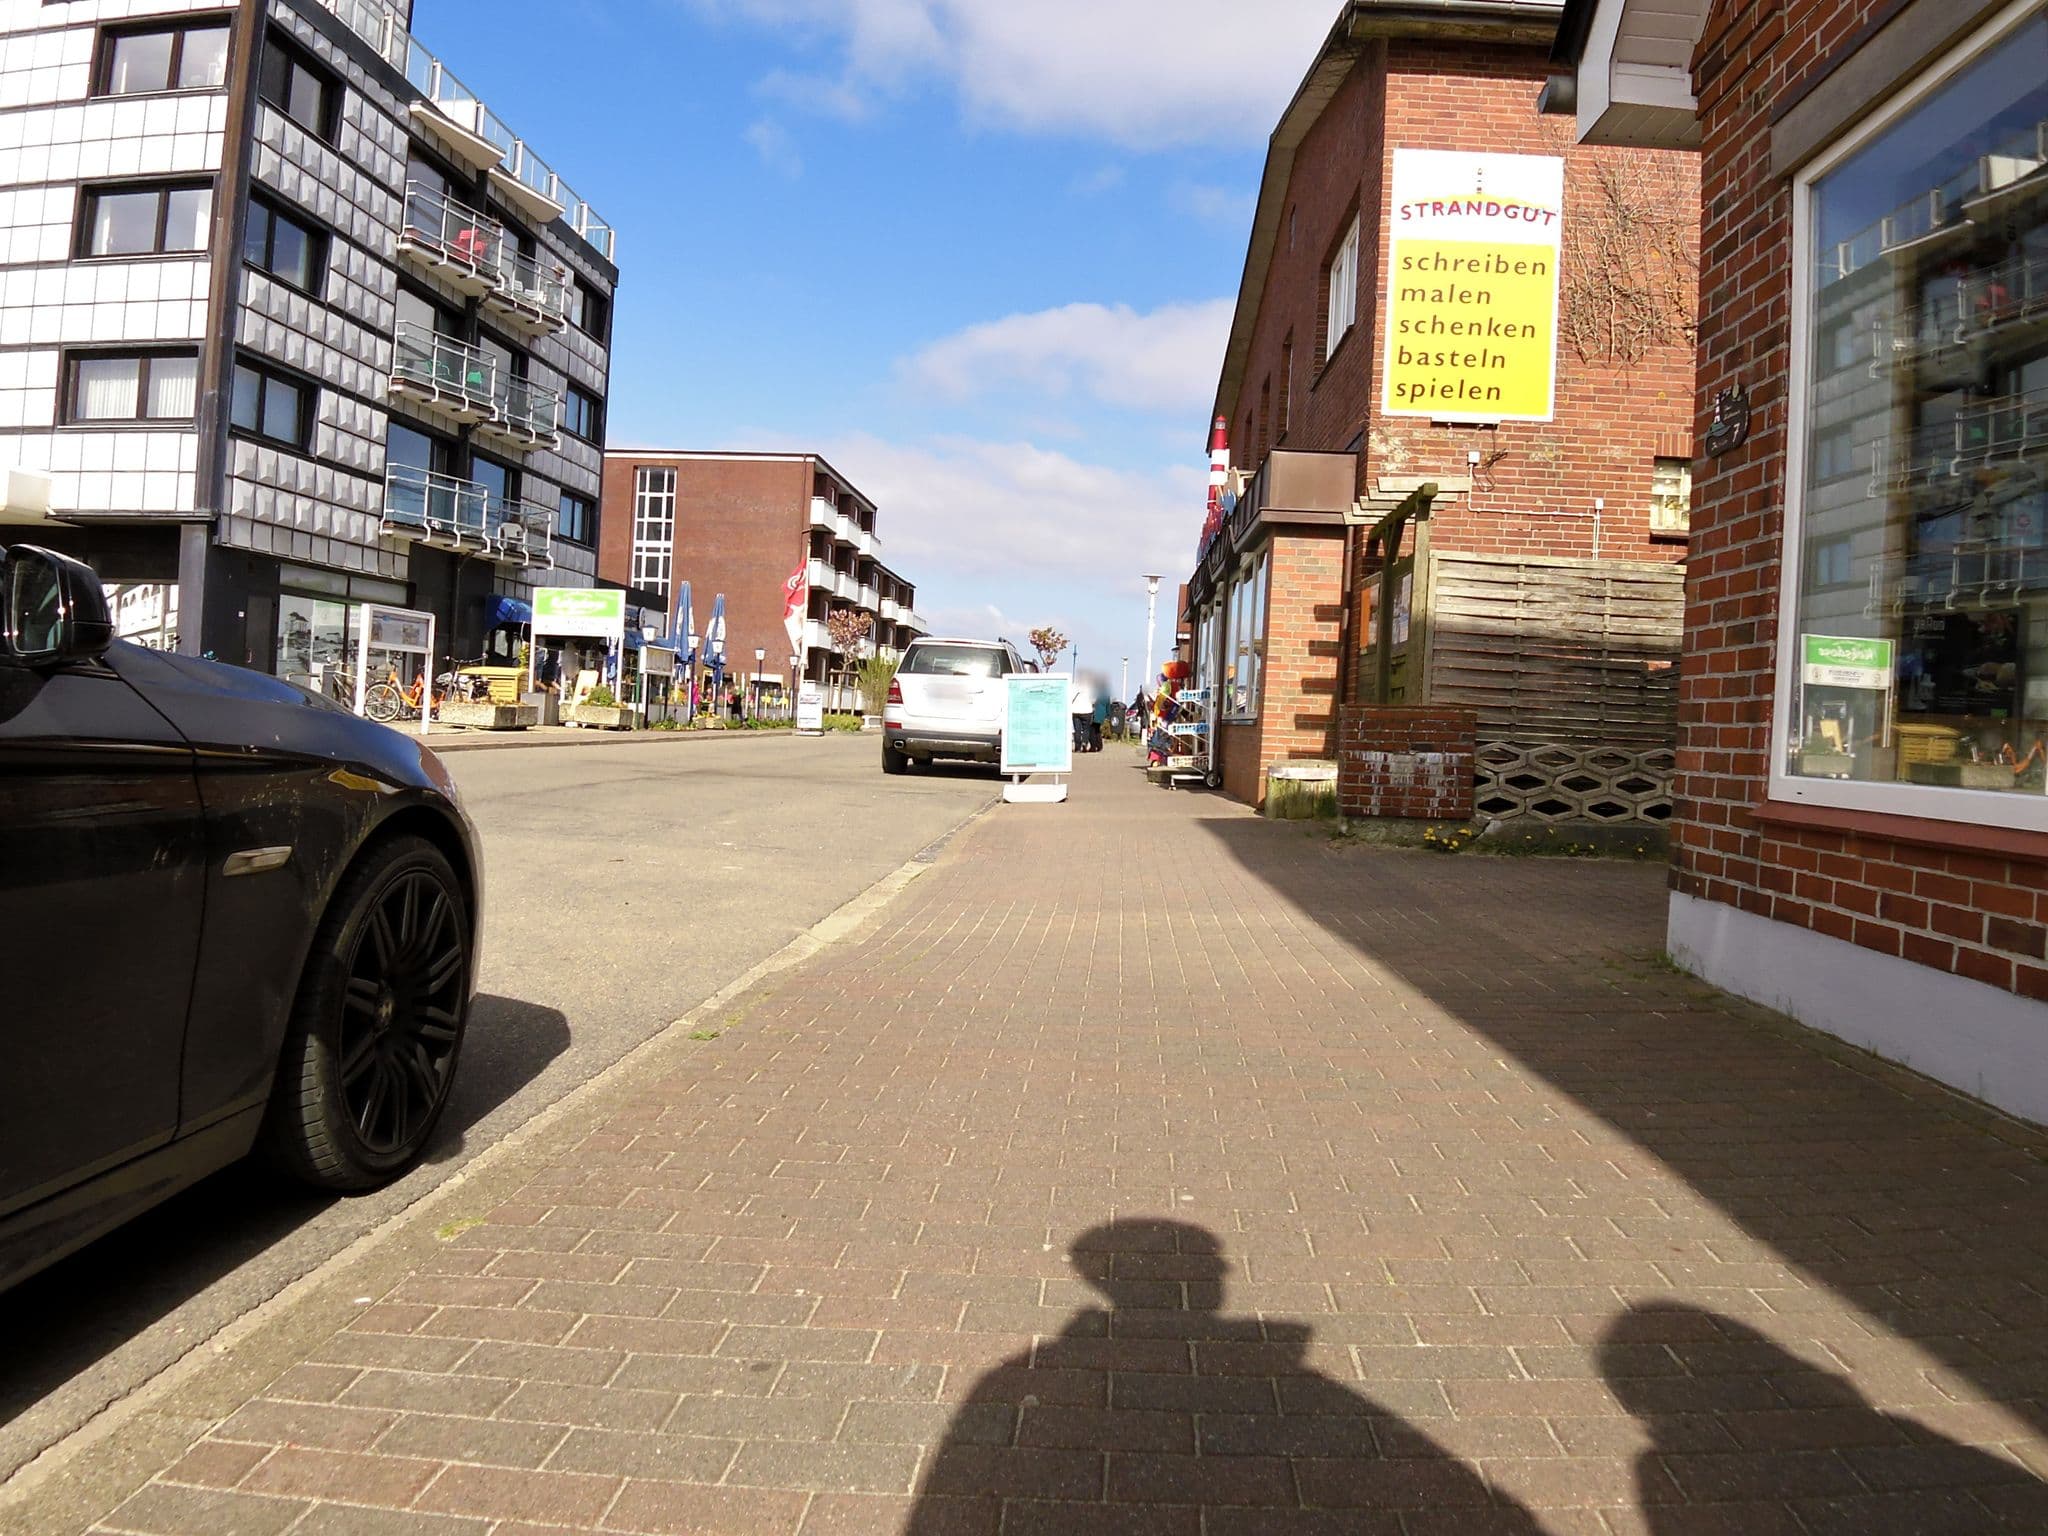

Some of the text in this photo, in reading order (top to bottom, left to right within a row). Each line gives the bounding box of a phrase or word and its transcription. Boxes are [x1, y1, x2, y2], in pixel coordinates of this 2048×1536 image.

[1400, 200, 1557, 226] STRANDGUT
[1402, 251, 1546, 276] schreiben
[1401, 284, 1491, 305] malen
[1399, 314, 1536, 339] schenken
[1397, 345, 1506, 369] basteln
[1395, 378, 1502, 403] spielen
